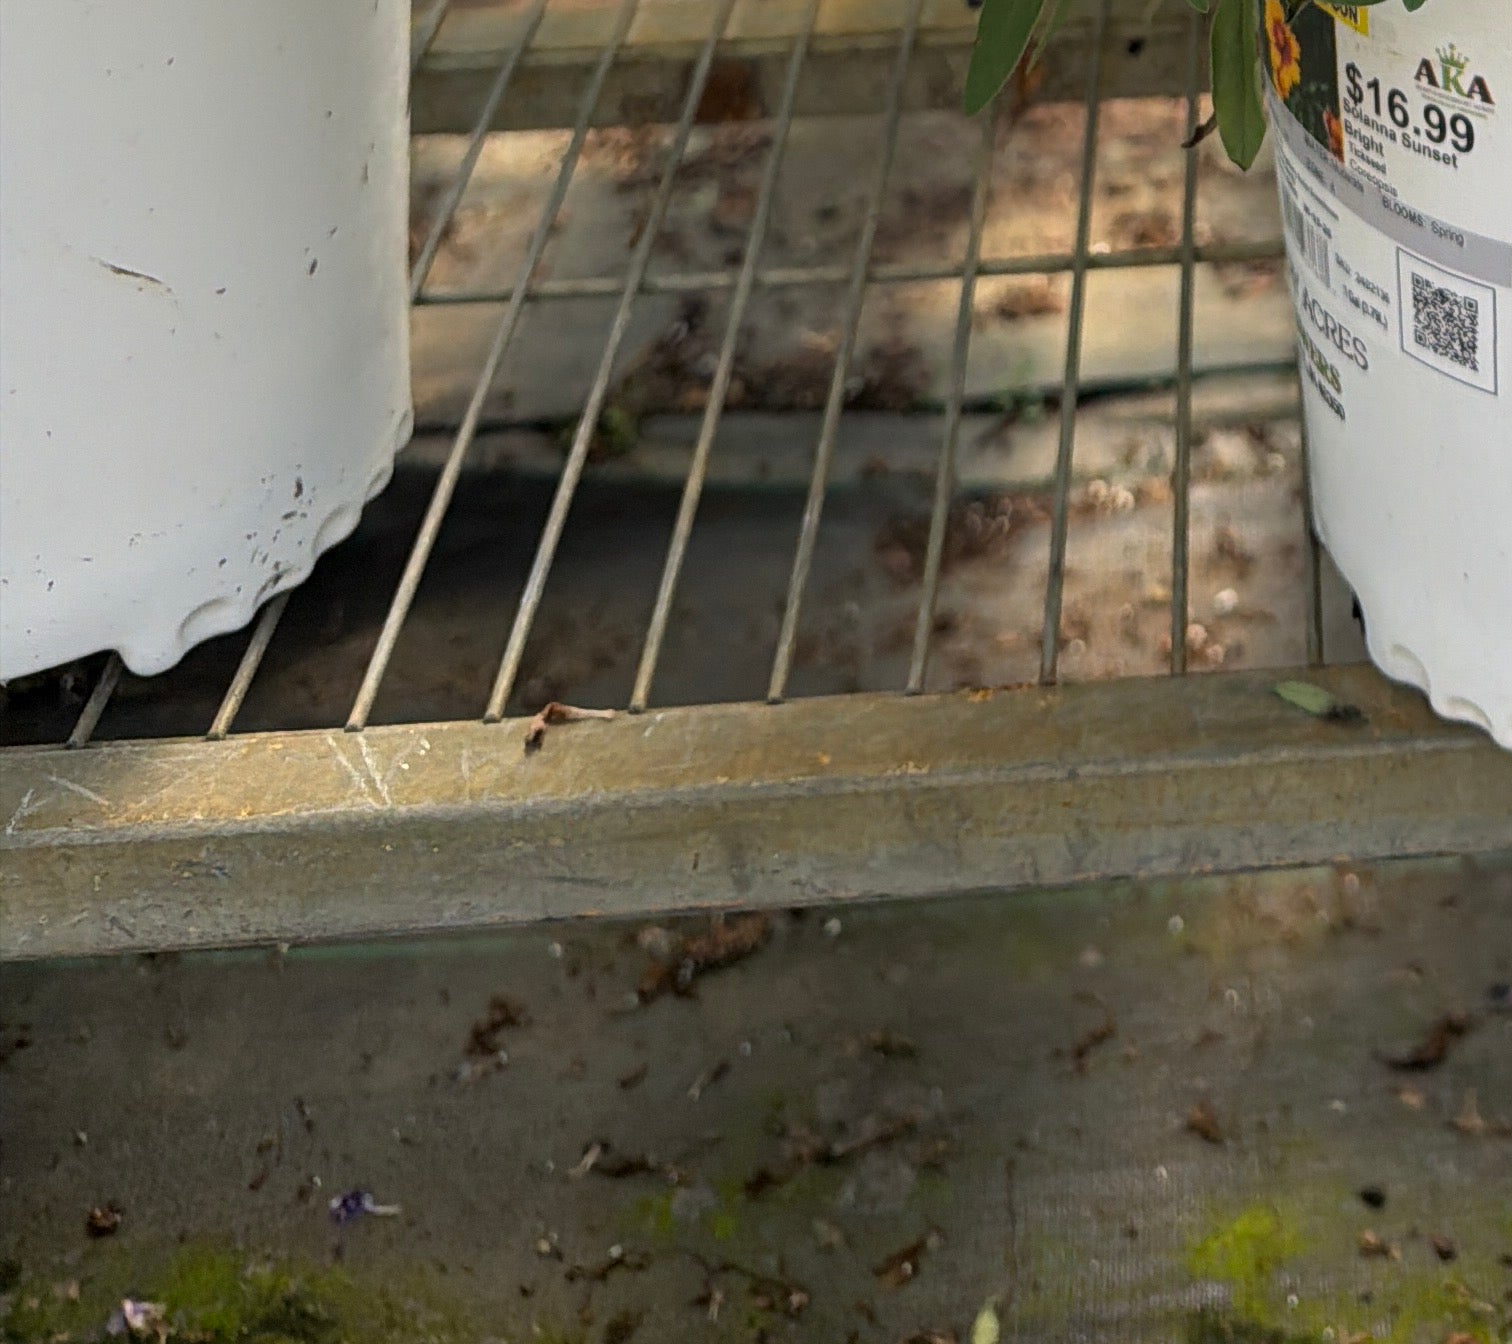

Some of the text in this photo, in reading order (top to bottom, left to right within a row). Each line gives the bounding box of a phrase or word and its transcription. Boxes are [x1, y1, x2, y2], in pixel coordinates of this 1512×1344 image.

[1345, 61, 1476, 153] $16.99
[1414, 56, 1496, 105] AKA
[1343, 97, 1398, 143] Solanna
[1401, 132, 1459, 170] Sunset
[1343, 118, 1385, 157] Bright
[1431, 220, 1465, 249] Spring
[1302, 286, 1369, 371] ACRES
